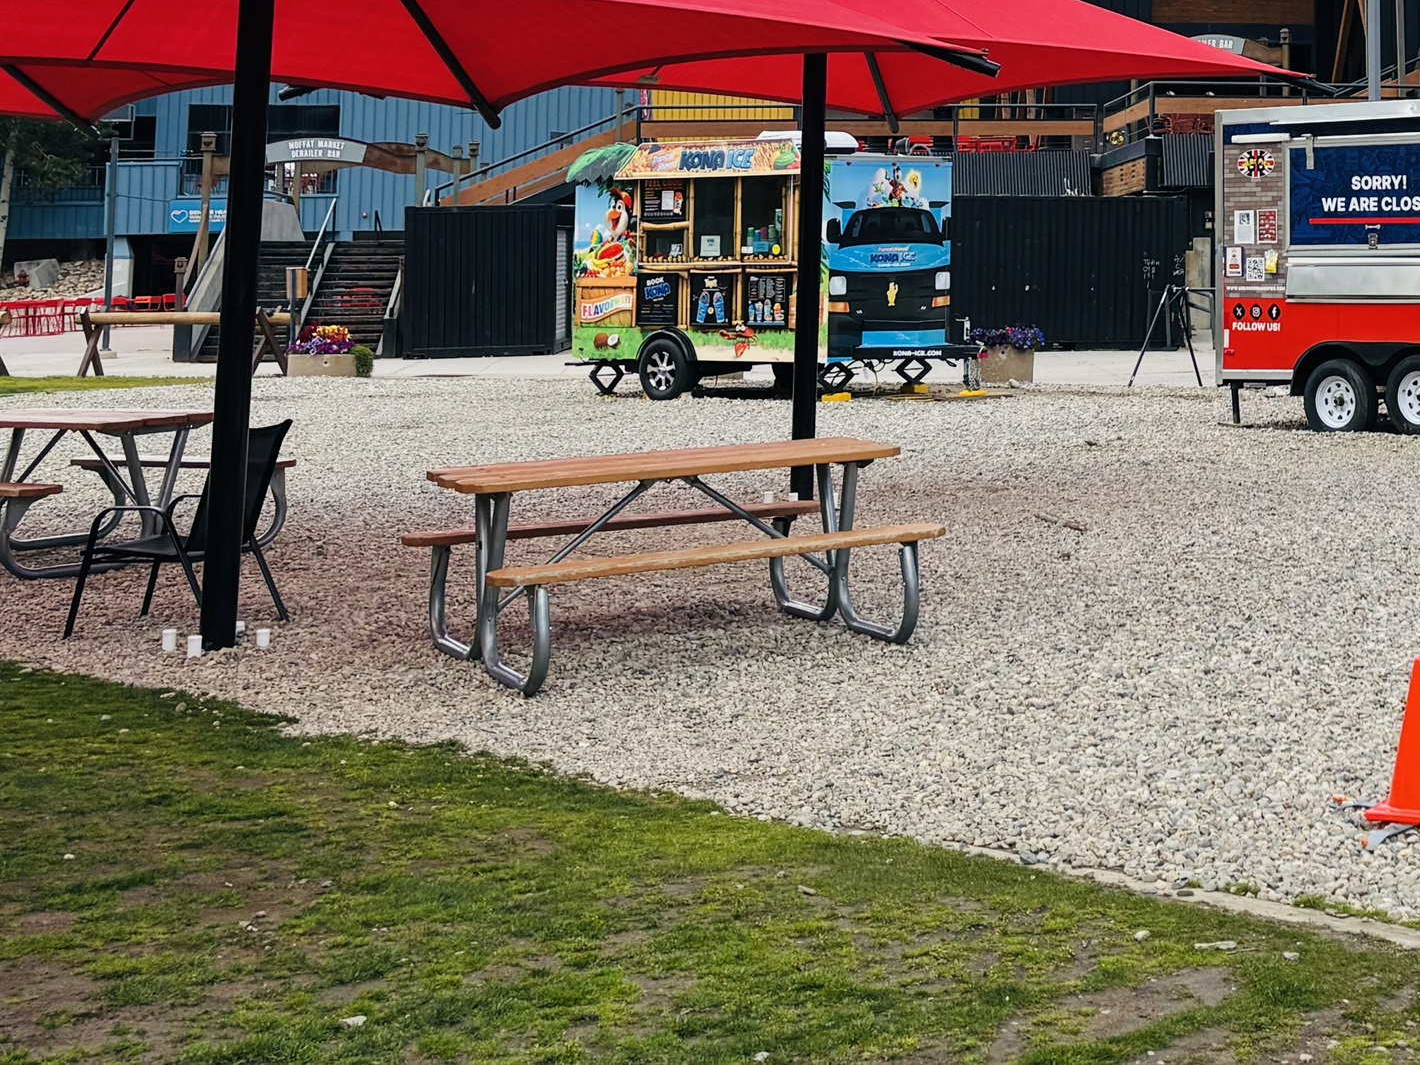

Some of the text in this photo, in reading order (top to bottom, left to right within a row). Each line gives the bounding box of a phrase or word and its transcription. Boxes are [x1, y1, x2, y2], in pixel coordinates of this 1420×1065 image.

[1219, 39, 1234, 49] BAR
[288, 139, 345, 150] MOFFAT MARKET
[291, 149, 341, 158] DERAILER BAR
[679, 150, 725, 171] KONA
[726, 147, 755, 169] ICE
[1351, 175, 1407, 191] SORRY!
[1322, 197, 1346, 212] WE
[1348, 197, 1378, 211] ARE
[870, 252, 916, 263] KONA ICE
[646, 276, 664, 286] BOOK
[644, 283, 670, 300] KONA
[1232, 322, 1281, 331] FOLLOW US!
